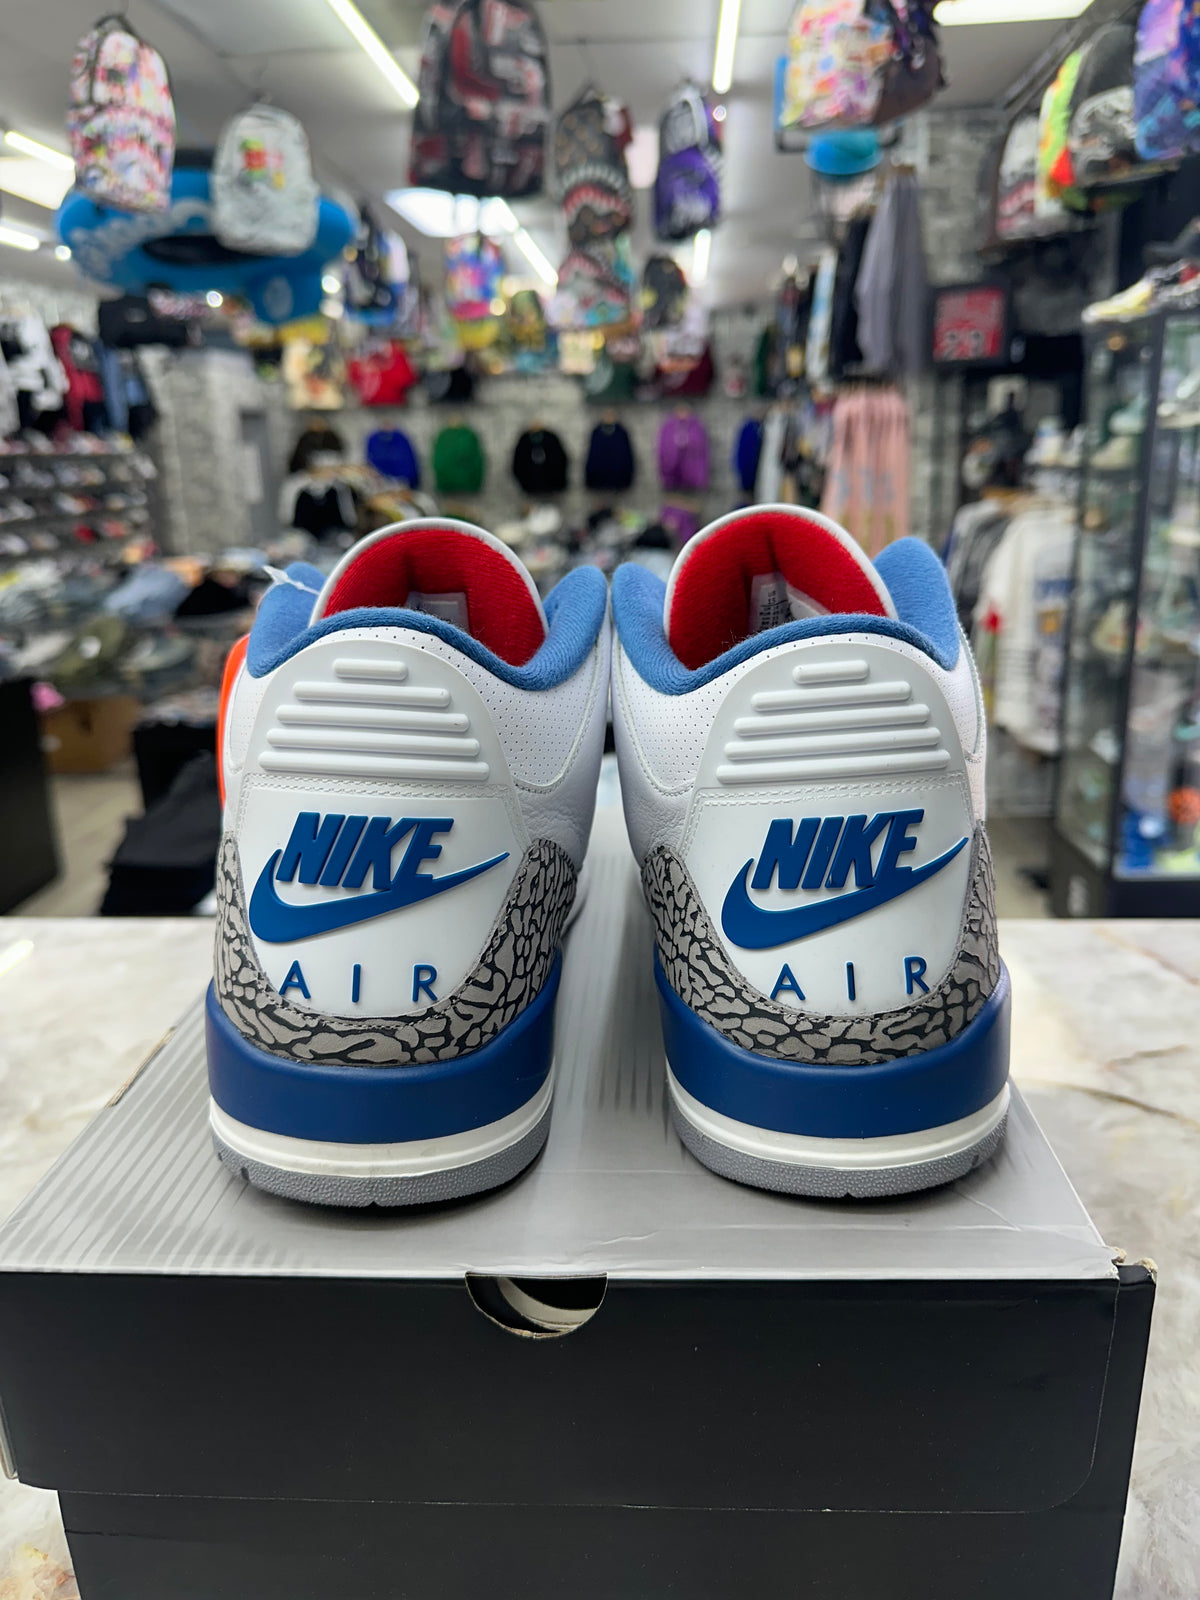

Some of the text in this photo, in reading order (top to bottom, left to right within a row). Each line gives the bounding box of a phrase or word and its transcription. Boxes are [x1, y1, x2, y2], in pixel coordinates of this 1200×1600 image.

[276, 811, 454, 890] NIKE
[751, 808, 925, 889] NIKE
[278, 960, 438, 1003] AIR
[770, 956, 930, 1001] AIR
